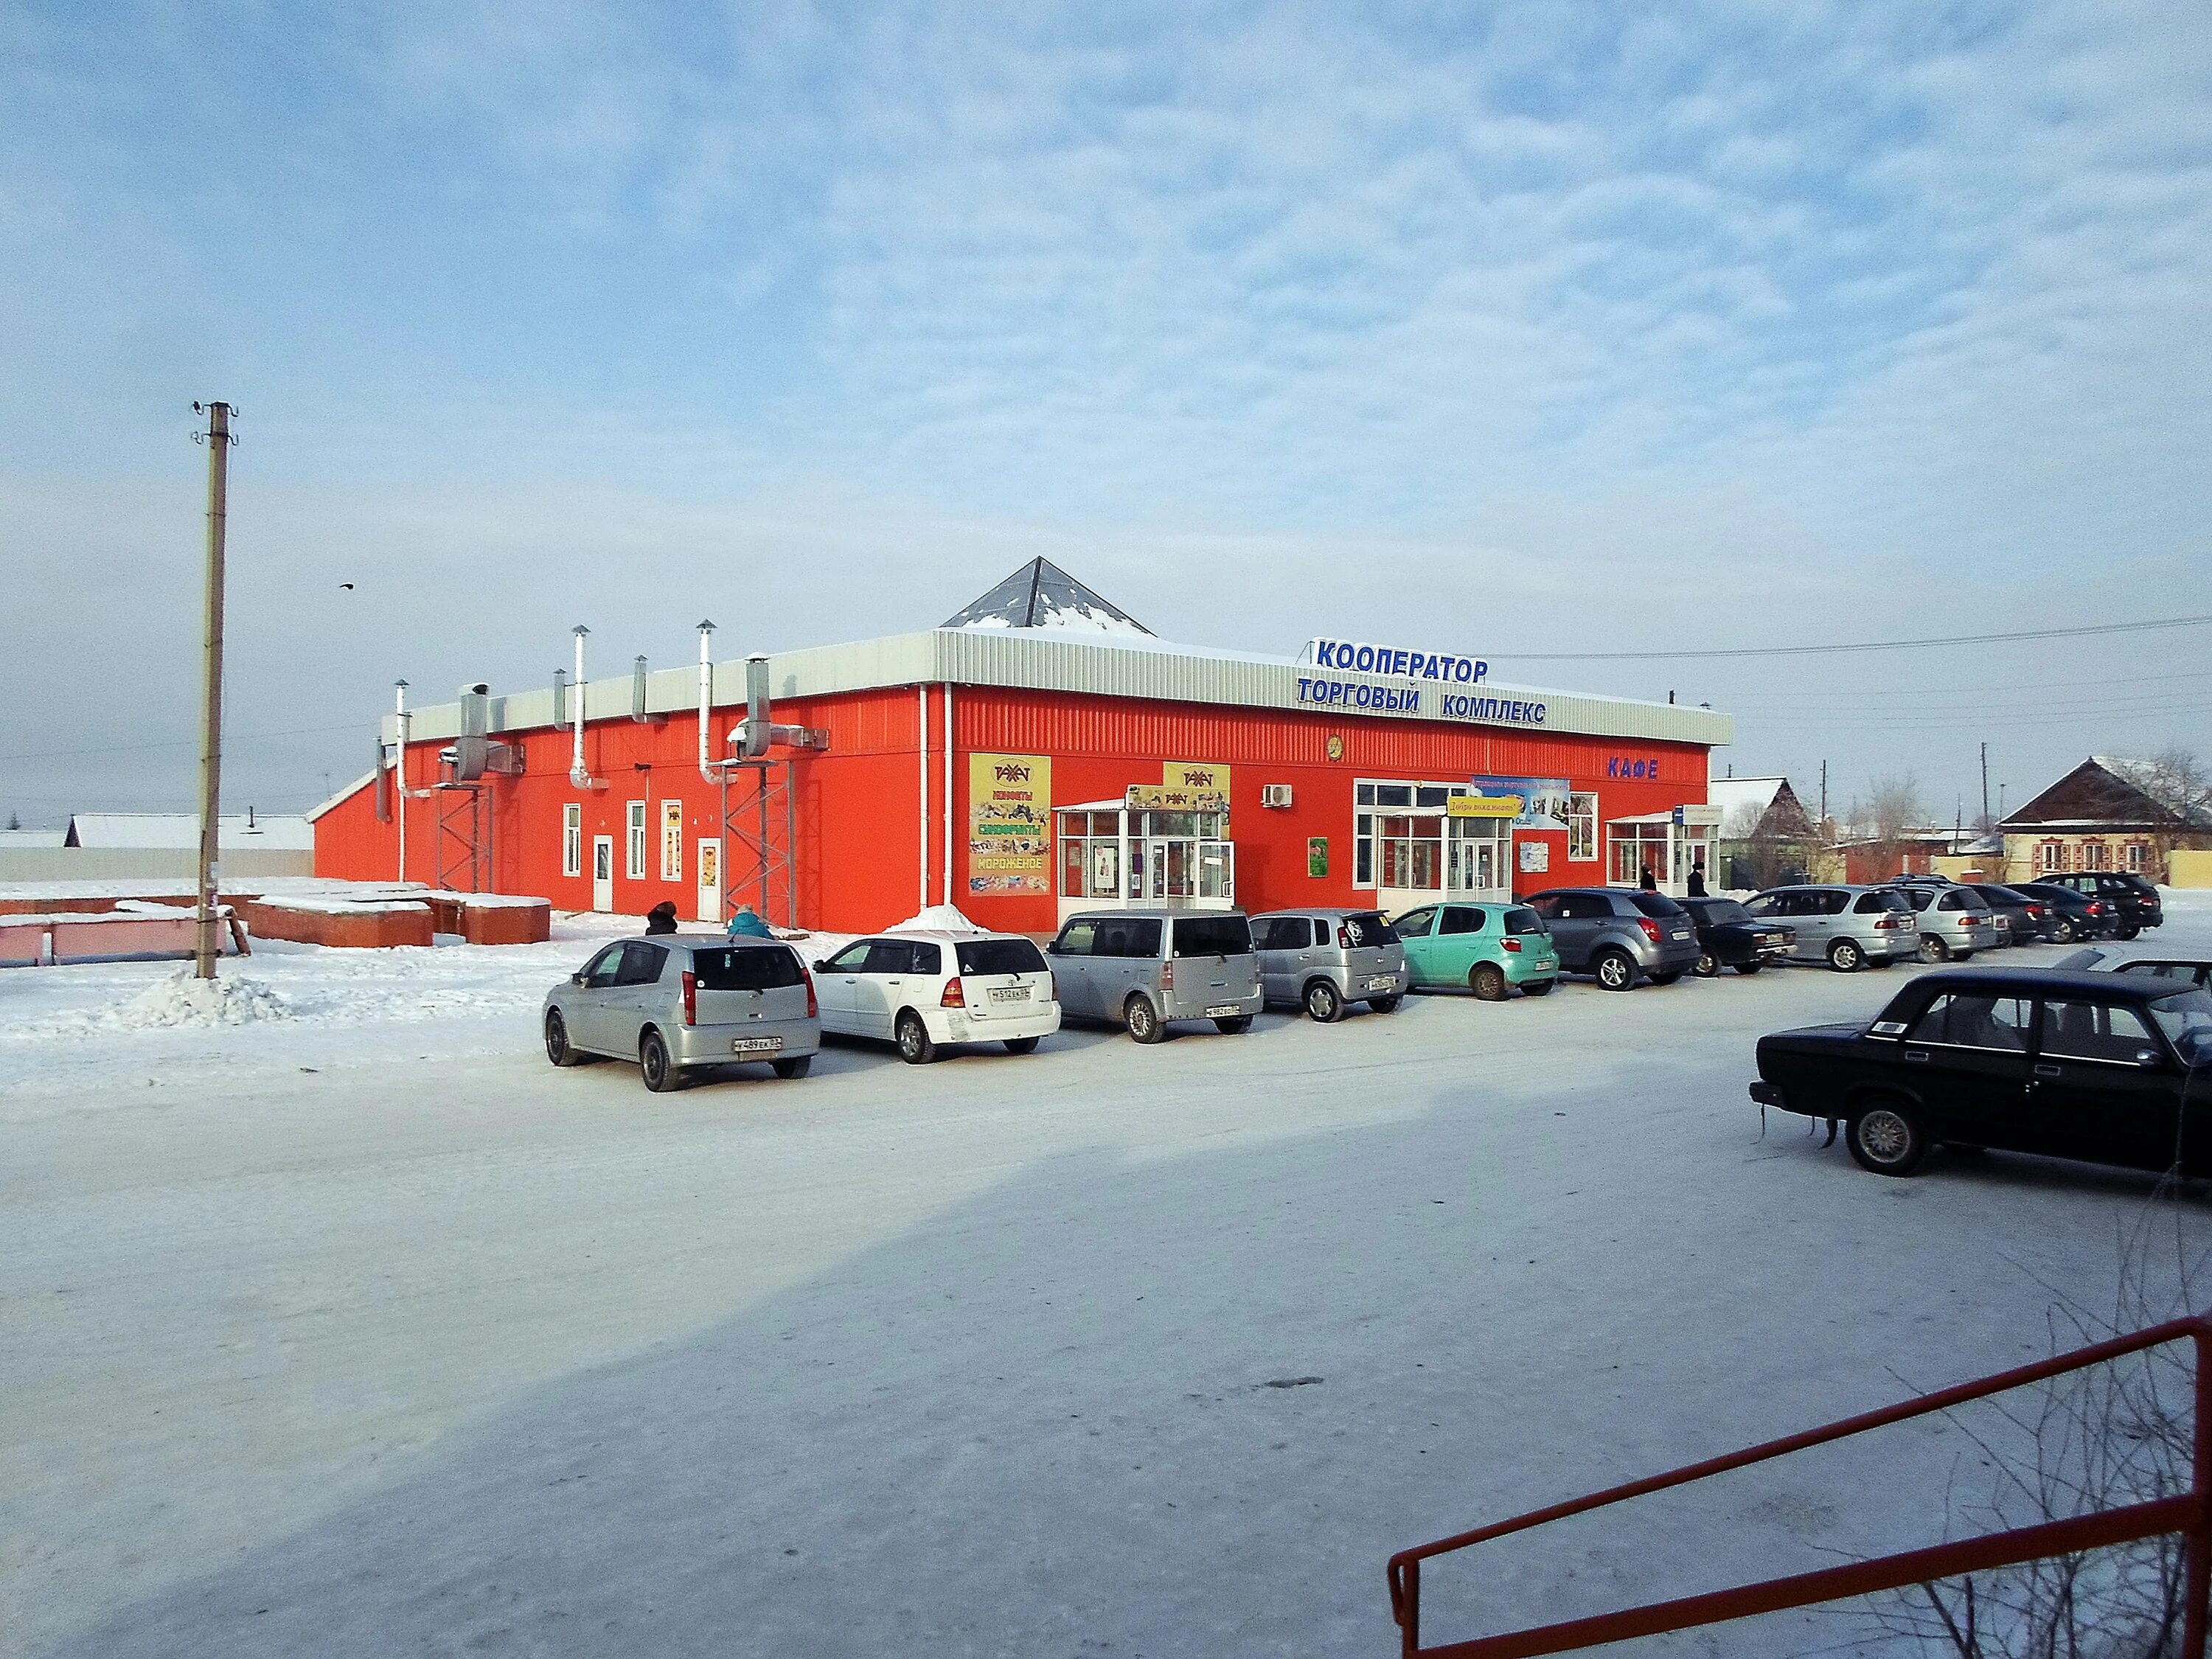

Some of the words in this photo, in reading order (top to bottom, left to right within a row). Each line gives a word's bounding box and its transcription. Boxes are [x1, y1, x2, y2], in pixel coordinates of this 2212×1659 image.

[1317, 641, 1489, 684] КООПЕРАТОР
[1298, 678, 1420, 712] ТОРГОВЫЙ
[1442, 694, 1546, 723] КОМПЛЕКС
[1608, 757, 1658, 779] КАФЕ
[977, 857, 1042, 870] МОРОЖЕНОЕ
